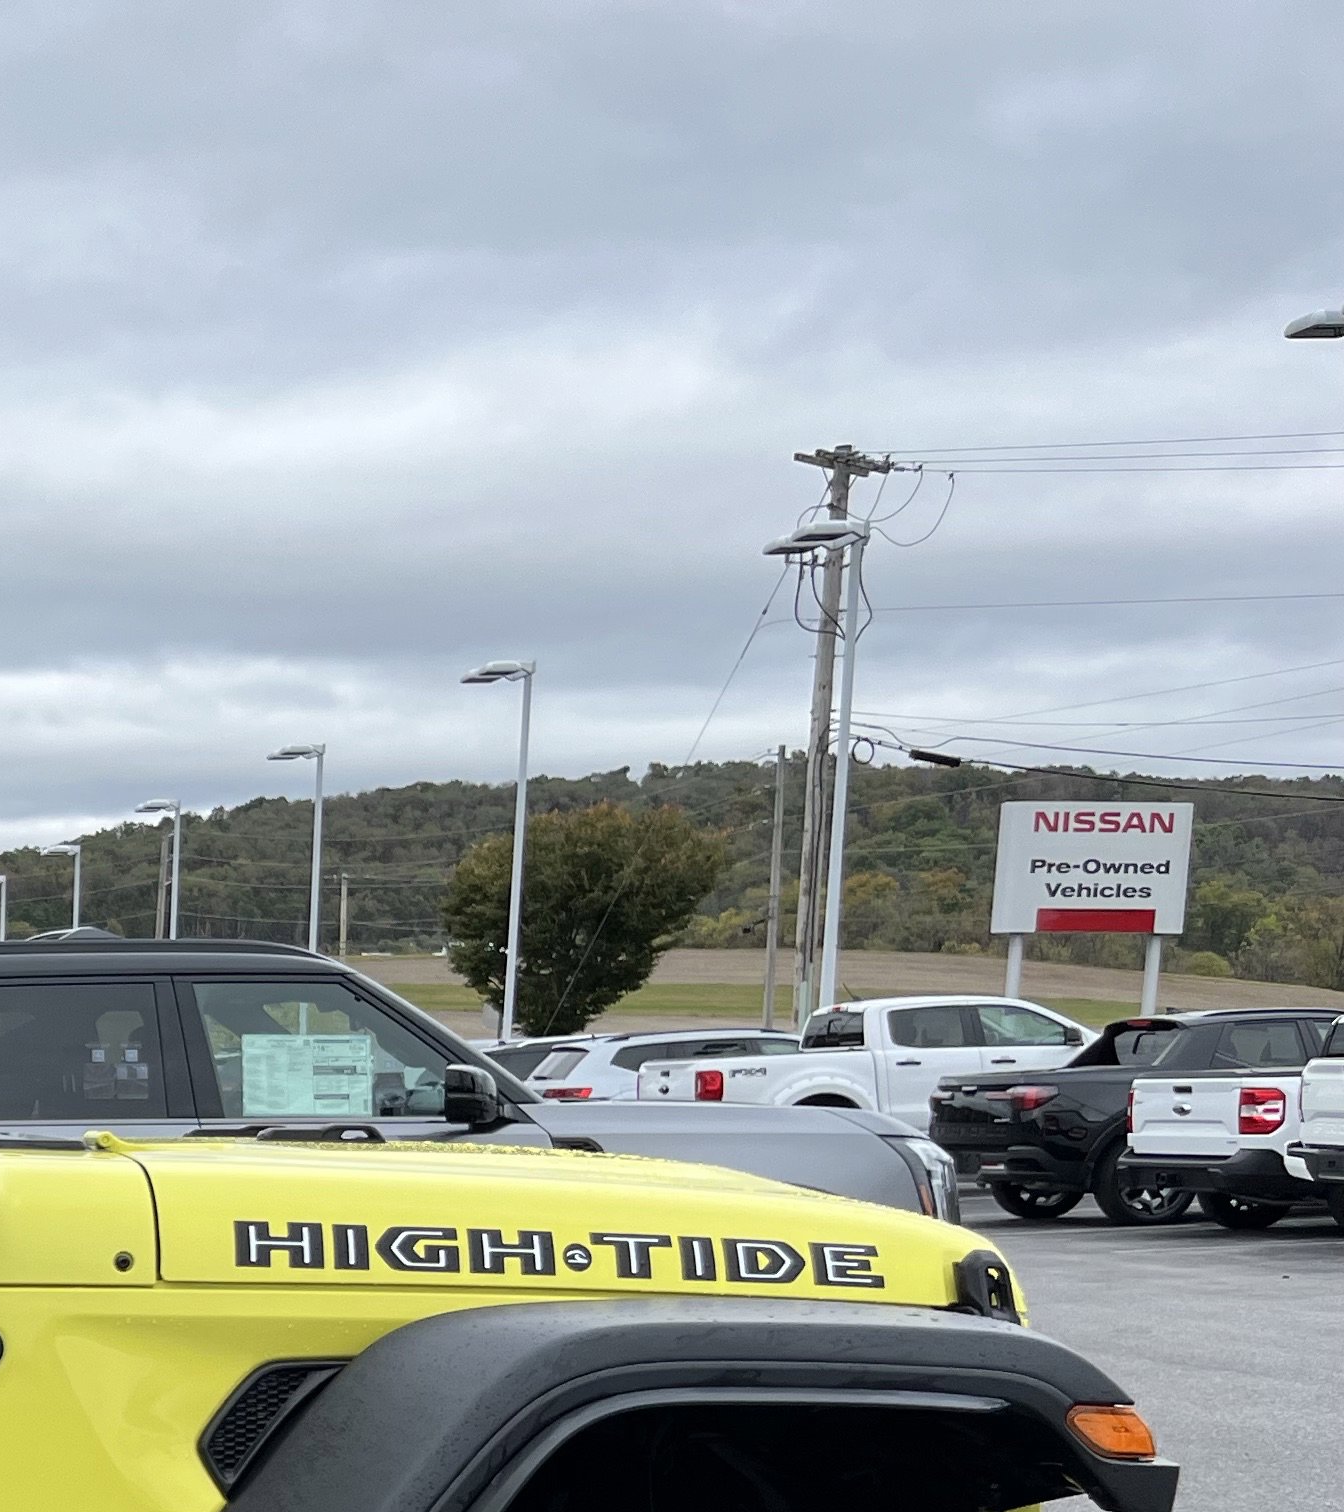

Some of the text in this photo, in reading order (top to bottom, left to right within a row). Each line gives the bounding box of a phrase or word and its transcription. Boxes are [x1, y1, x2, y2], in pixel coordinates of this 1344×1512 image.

[1033, 811, 1175, 833] NISSAN
[1029, 858, 1171, 875] Pre-Owned
[1045, 882, 1152, 898] Vehicles
[233, 1220, 886, 1289] HIGH TIDE
